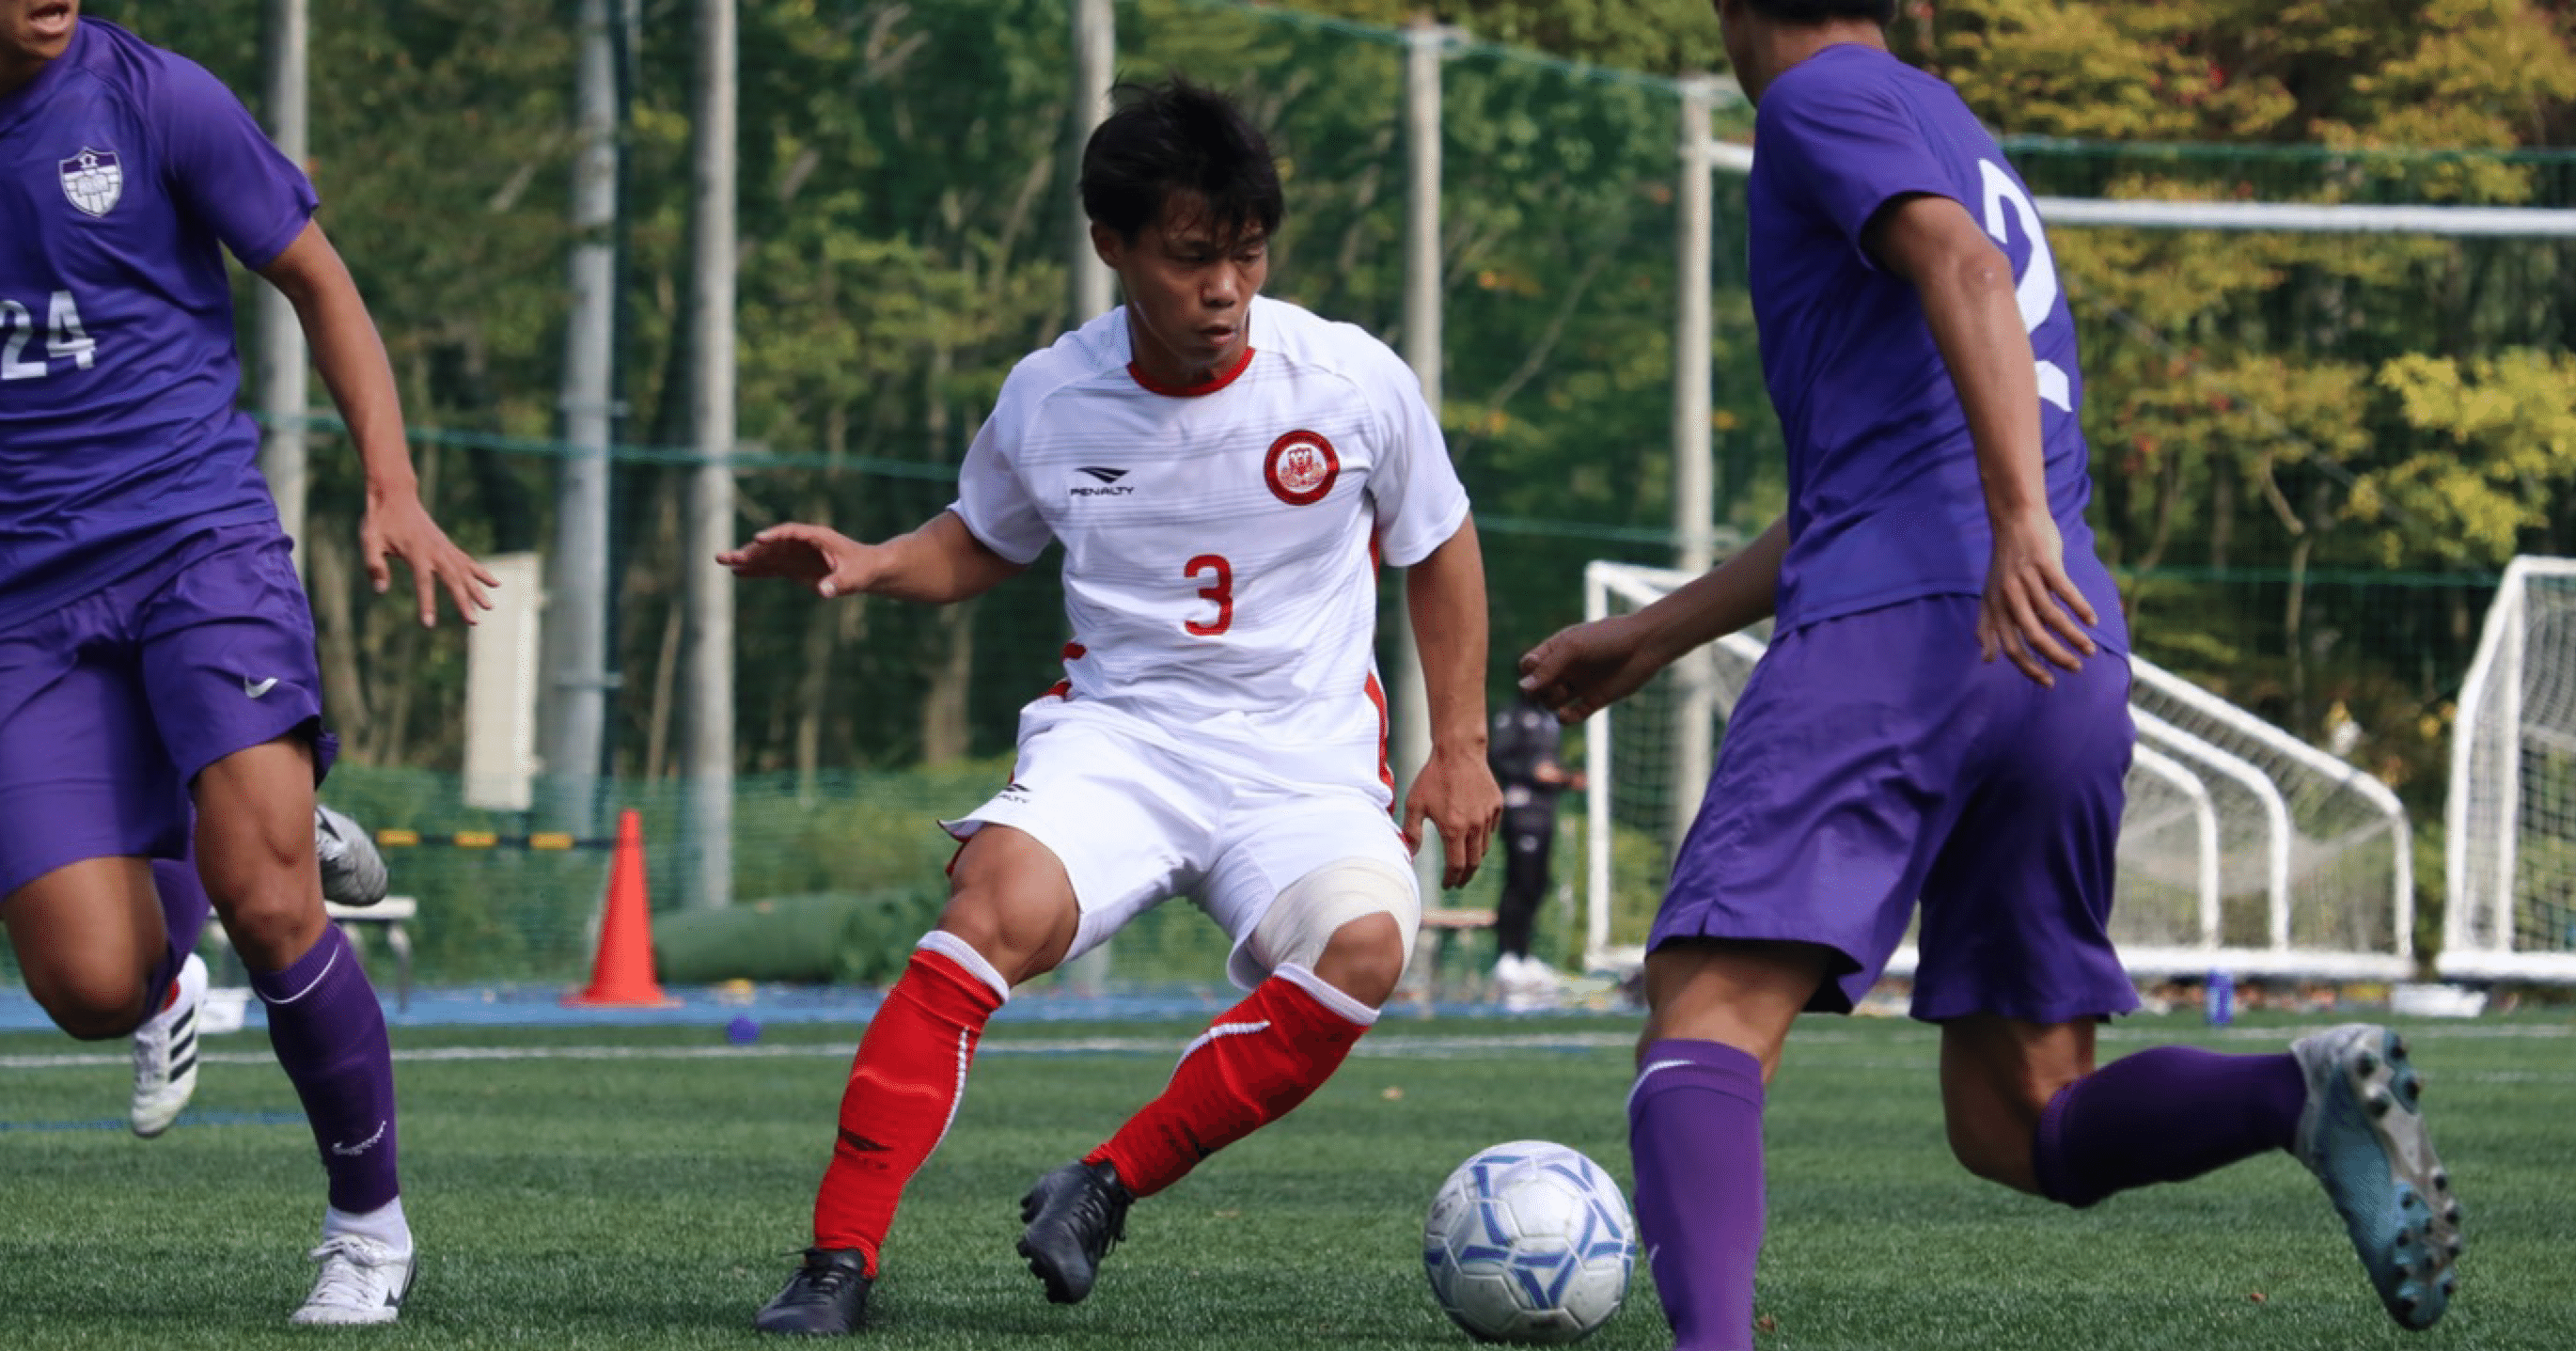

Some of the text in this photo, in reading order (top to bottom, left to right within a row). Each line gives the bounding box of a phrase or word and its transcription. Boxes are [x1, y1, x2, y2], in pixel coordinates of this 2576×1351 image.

[0, 291, 97, 380] 24
[1069, 486, 1136, 496] PENALTY
[1184, 553, 1233, 636] 3
